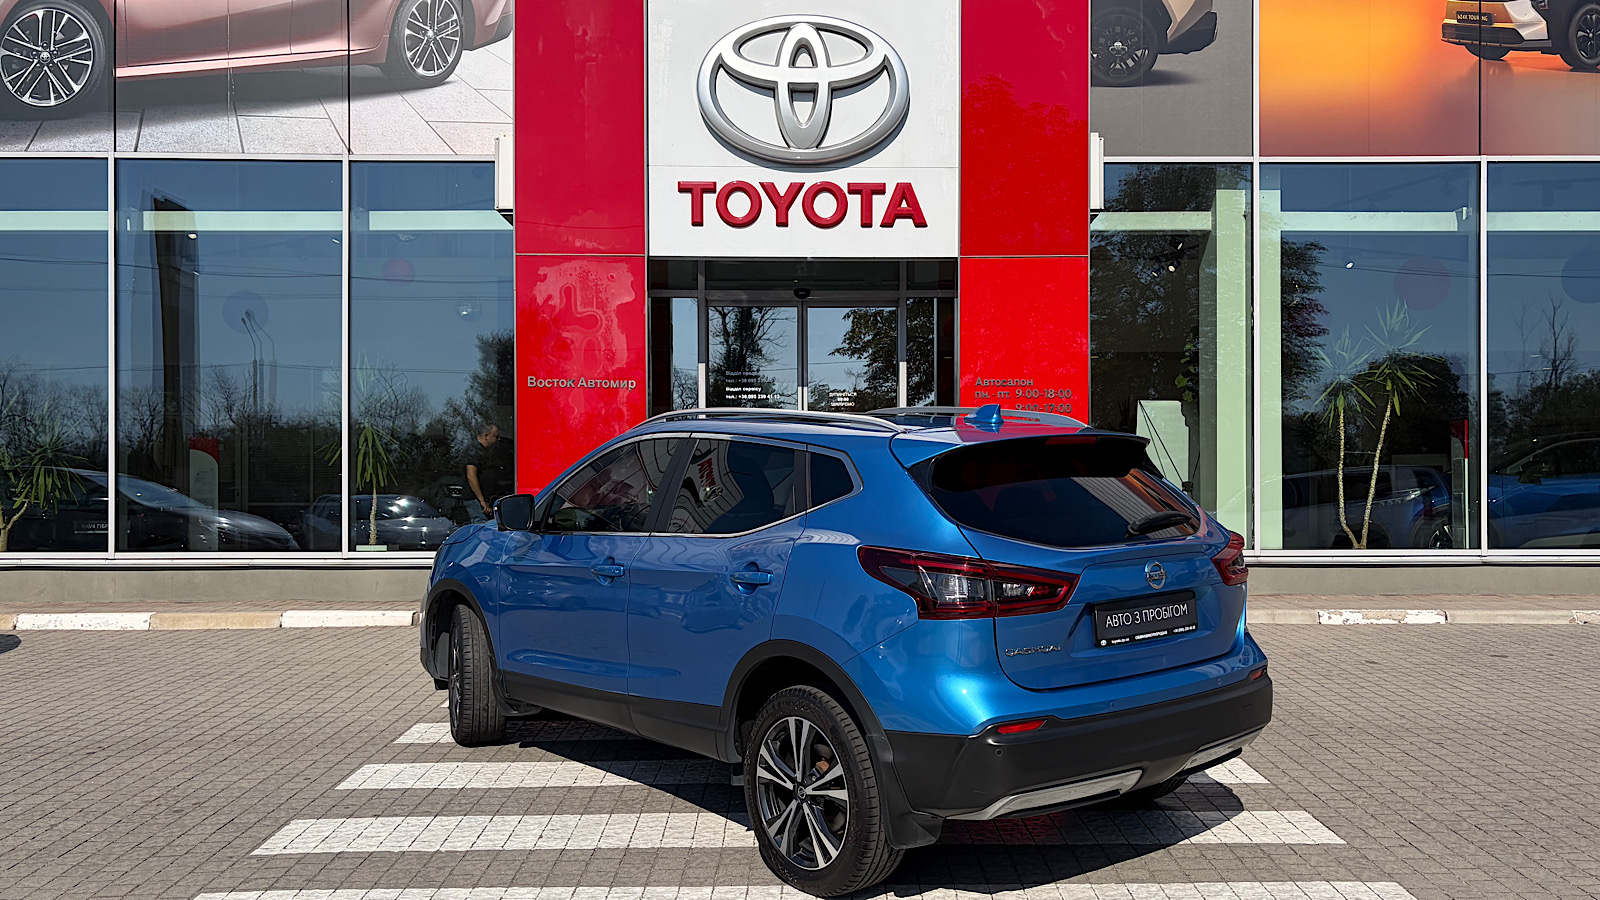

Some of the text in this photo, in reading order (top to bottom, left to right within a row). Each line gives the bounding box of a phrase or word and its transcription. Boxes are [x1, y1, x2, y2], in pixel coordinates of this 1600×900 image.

[678, 180, 928, 229] TOYOTA
[527, 376, 636, 391] Восток Автомир
[975, 377, 1034, 387] Автосалон
[1015, 388, 1072, 399] 9:00-18:00
[1105, 612, 1132, 628] АВТО
[1142, 603, 1188, 622] ПРОБІГОМ
[1005, 644, 1061, 657] QASHQAI
